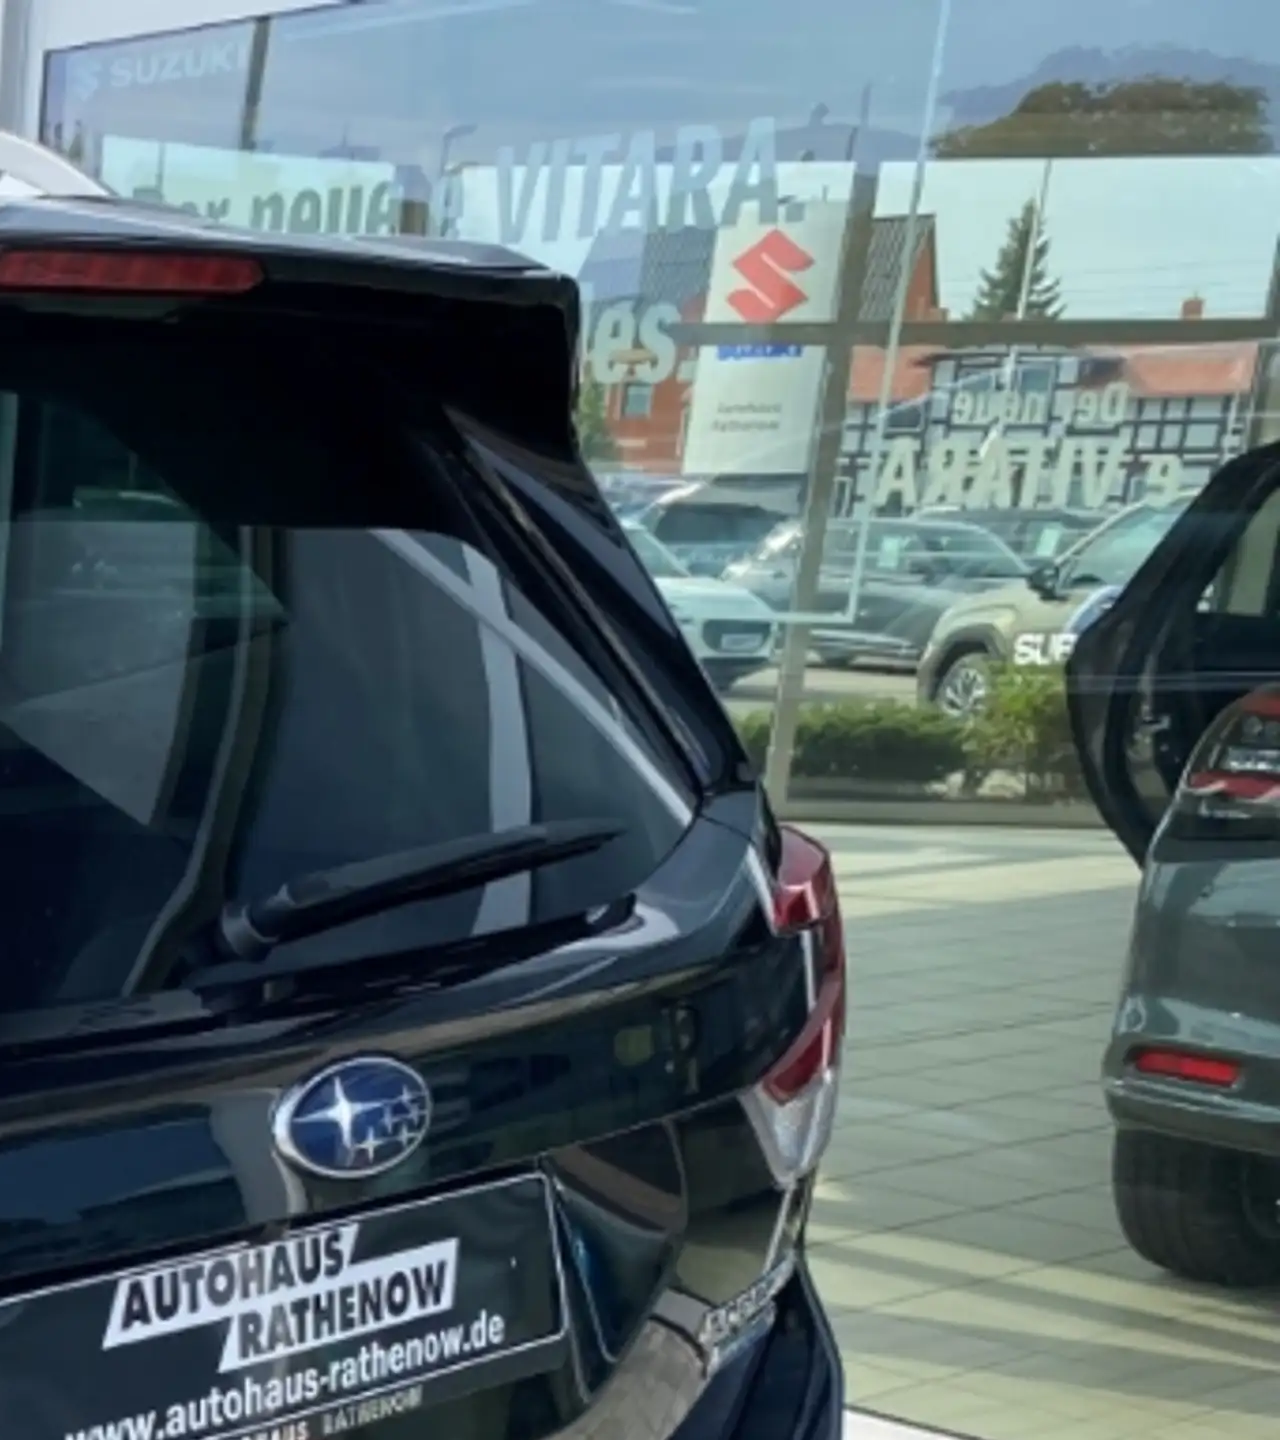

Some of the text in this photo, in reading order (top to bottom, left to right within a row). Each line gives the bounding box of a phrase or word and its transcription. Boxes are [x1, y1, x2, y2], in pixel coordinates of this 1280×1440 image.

[109, 42, 248, 88] SUZUKI
[496, 116, 805, 244] VITARA.
[121, 1228, 345, 1330] AUTOHAUS
[240, 1260, 447, 1360] RATHENOW
[322, 1384, 425, 1436] RATHENOW
